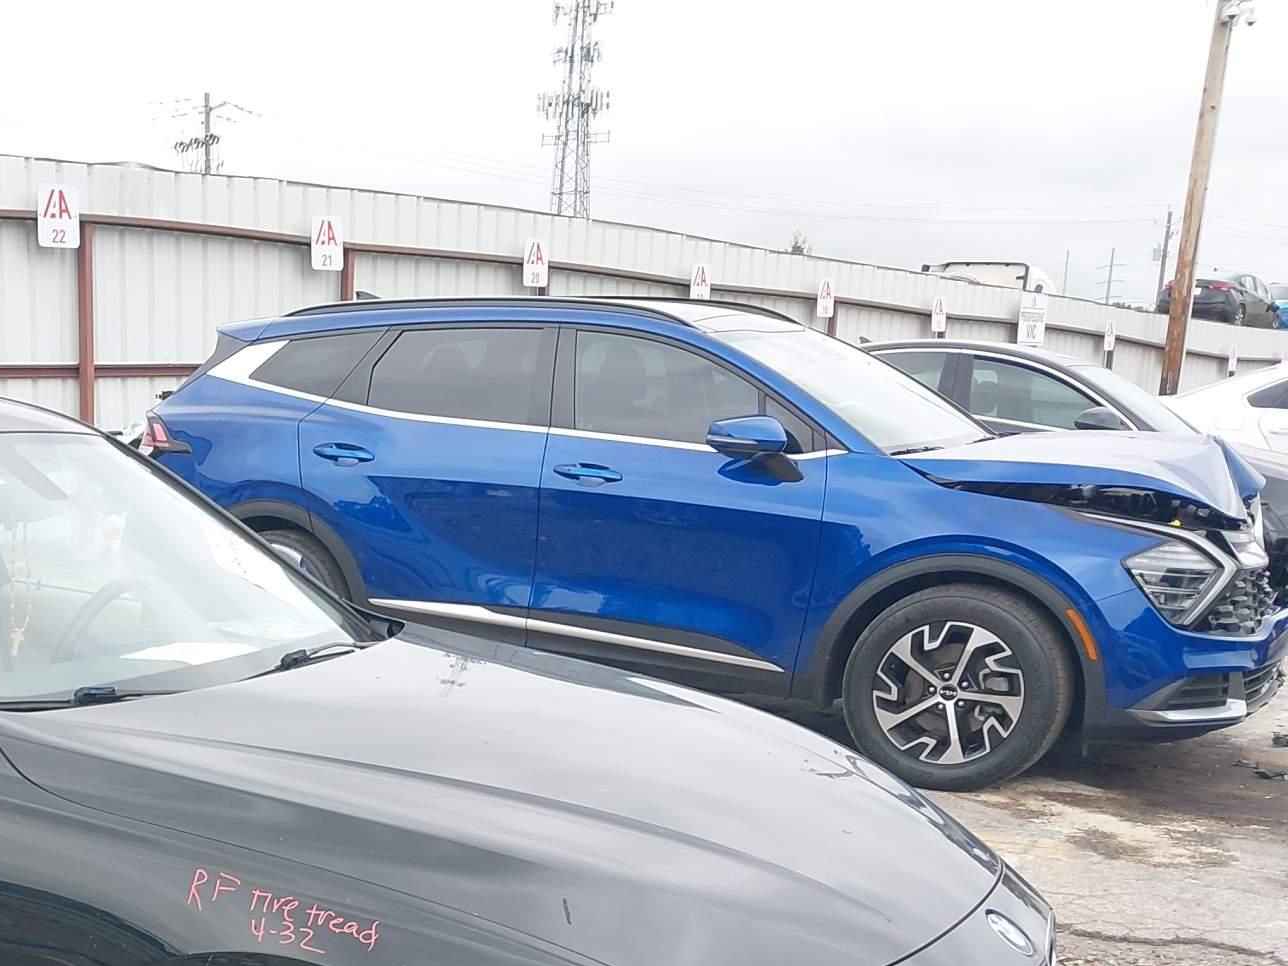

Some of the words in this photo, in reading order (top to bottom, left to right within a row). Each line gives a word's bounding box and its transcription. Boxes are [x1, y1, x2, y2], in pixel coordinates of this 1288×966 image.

[51, 228, 67, 244] 22
[321, 254, 333, 267] 21
[530, 271, 540, 284] 20
[305, 903, 380, 952] tread
[250, 917, 326, 955] 4-32
